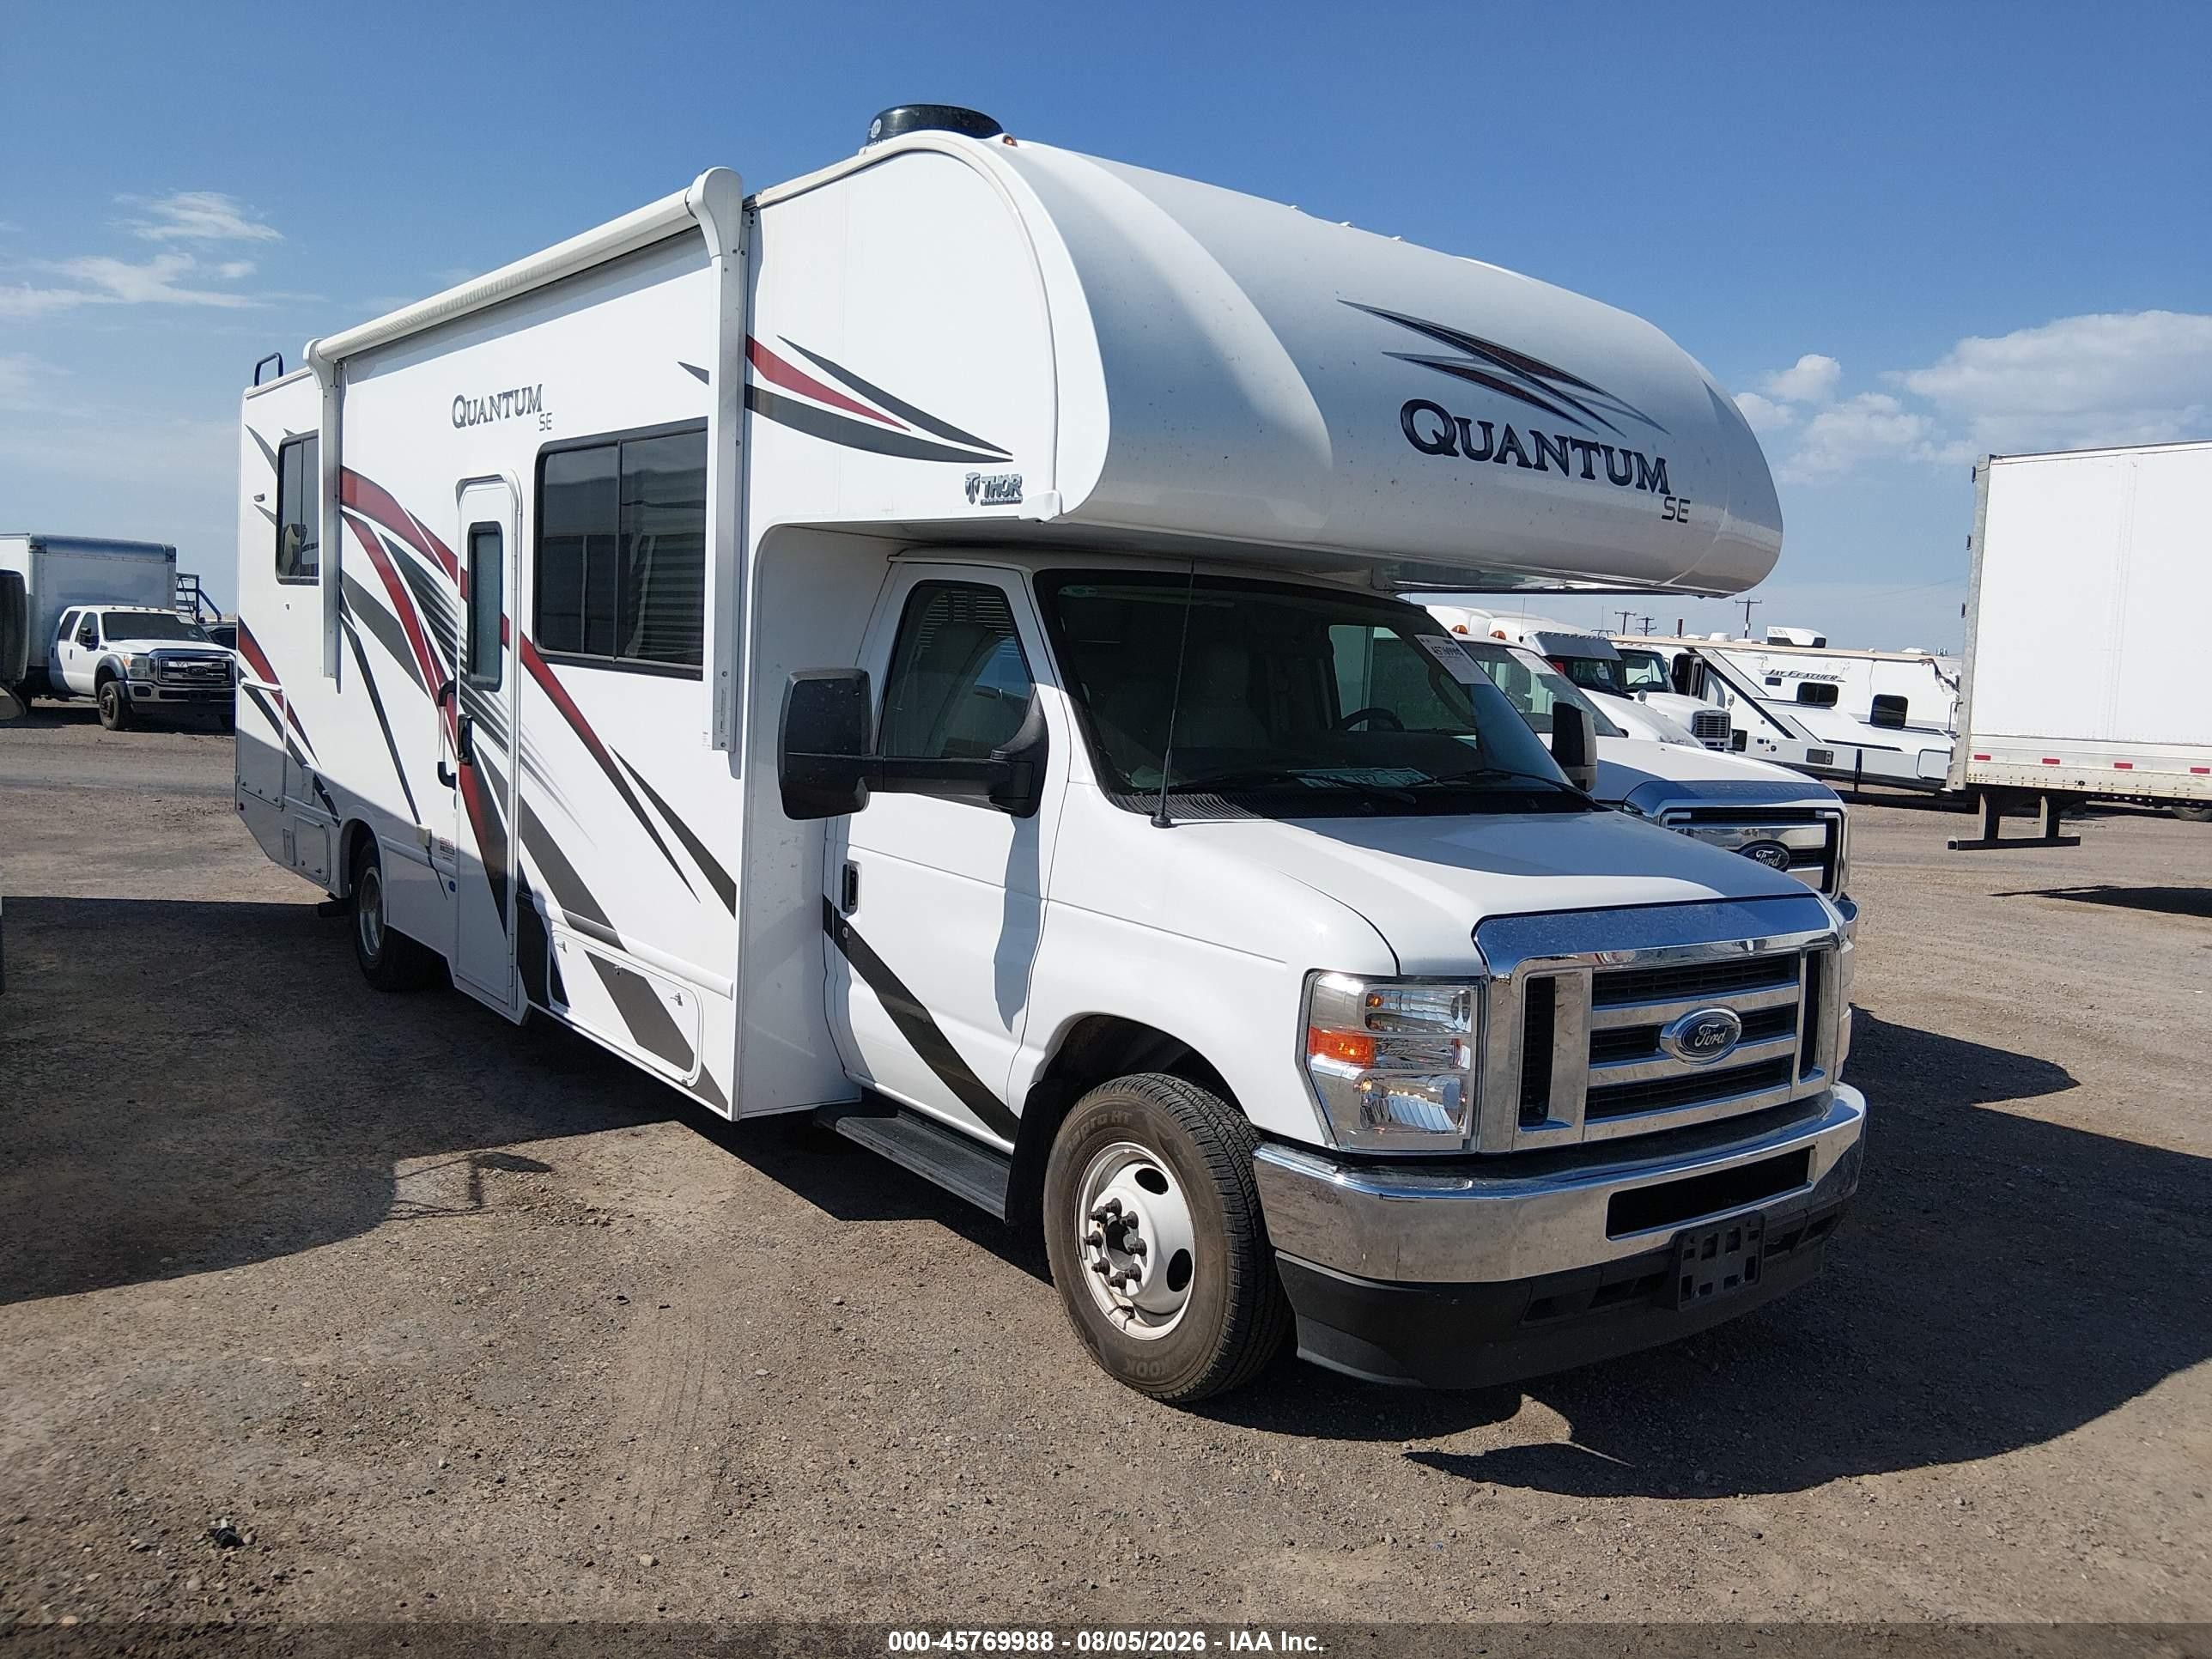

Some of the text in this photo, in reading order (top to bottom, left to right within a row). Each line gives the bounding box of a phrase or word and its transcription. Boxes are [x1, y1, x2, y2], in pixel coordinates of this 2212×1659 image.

[452, 384, 543, 428] QUANTUM
[538, 412, 552, 431] SE
[1400, 398, 1671, 495] QUANTUM
[981, 474, 1023, 499] THOR
[1661, 496, 1691, 524] SE
[1756, 849, 1782, 866] Ford
[1694, 1024, 1728, 1047] Ford
